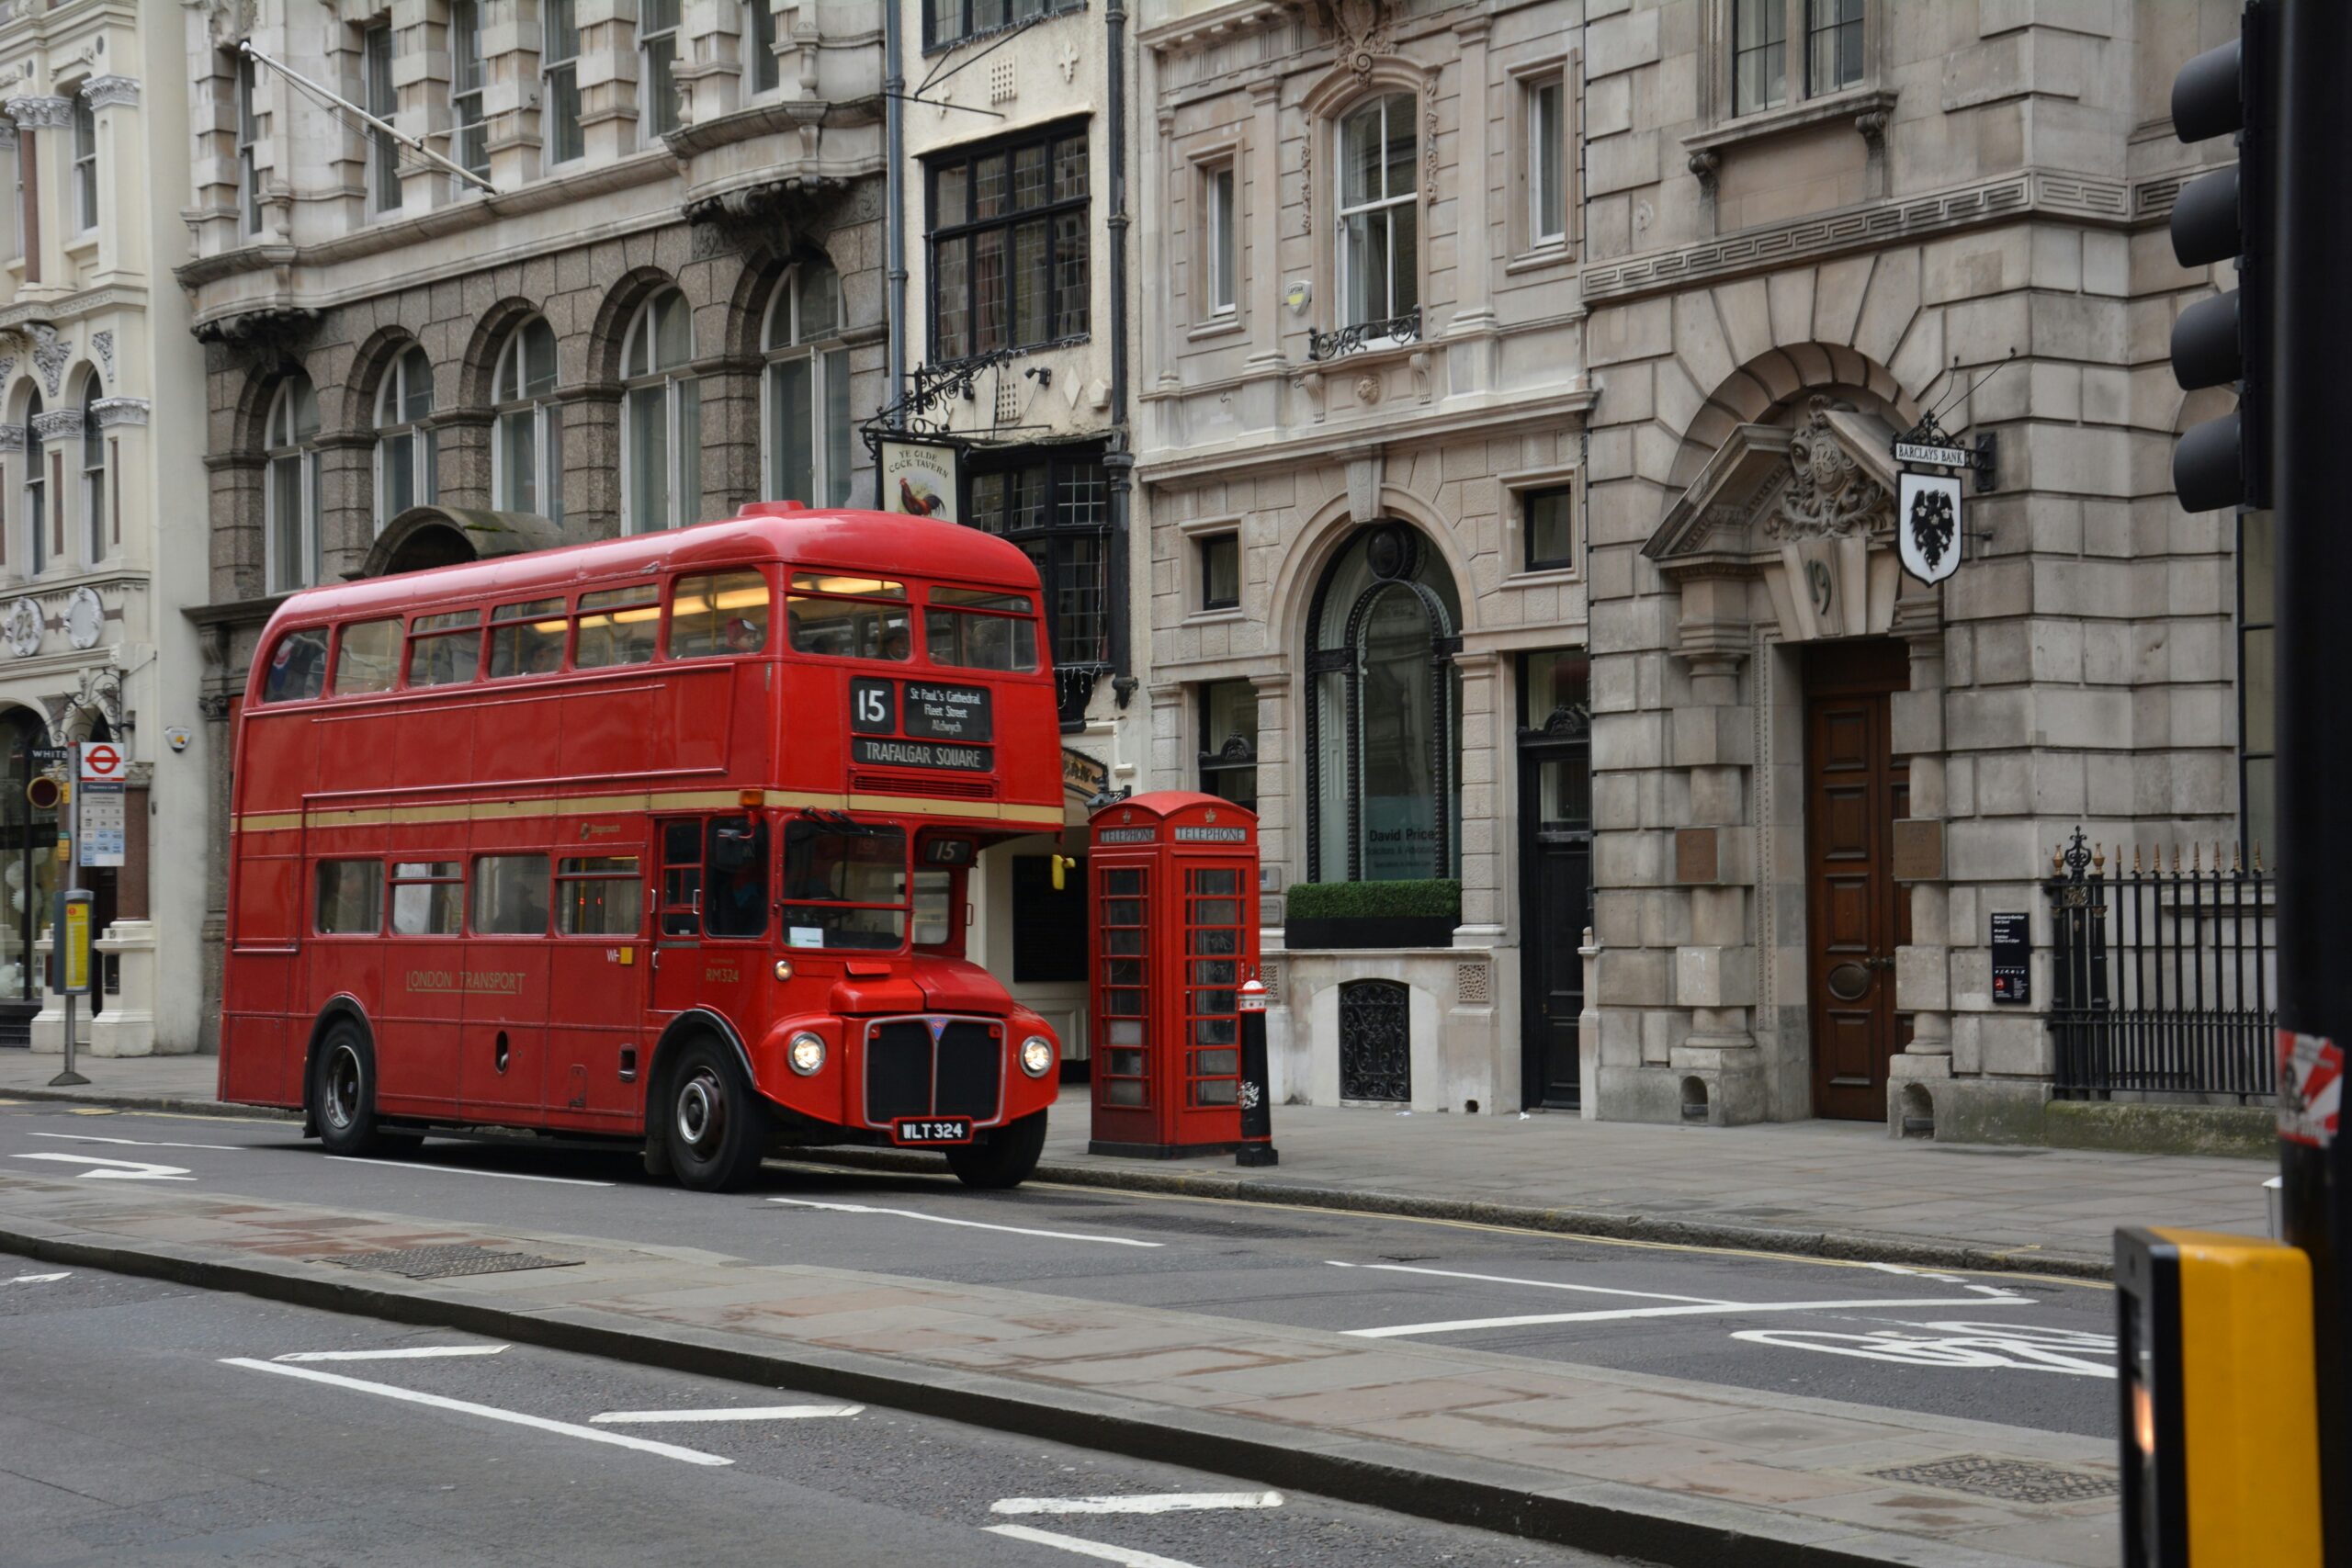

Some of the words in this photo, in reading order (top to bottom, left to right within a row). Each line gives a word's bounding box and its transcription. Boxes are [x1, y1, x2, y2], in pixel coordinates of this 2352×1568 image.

[899, 449, 910, 459] YE
[914, 449, 938, 462] OLDE
[1898, 445, 1939, 461] BARCLAYS
[1941, 450, 1963, 464] BANK
[888, 459, 912, 473] COCK
[915, 459, 949, 479] TAVERN
[1804, 558, 1832, 616] 19
[910, 687, 920, 700] St
[921, 689, 944, 702] Paul's
[946, 691, 981, 705] Cathedral
[858, 689, 886, 722] 15
[924, 704, 944, 716] Fleet
[945, 705, 968, 718] Street
[931, 719, 963, 735] Aldwych
[865, 742, 932, 764] TRAFALGAR
[936, 748, 981, 768] SQUARE
[1103, 829, 1155, 842] TELEPHONE
[1178, 829, 1243, 840] TELEPHONE
[1369, 829, 1401, 841] David
[1406, 828, 1434, 840] Price
[936, 840, 958, 860] 15
[406, 970, 453, 991] LONDON
[458, 972, 526, 995] TRANSPORT
[705, 968, 739, 983] RM324
[902, 1123, 932, 1139] WLT
[933, 1122, 963, 1139] 324
